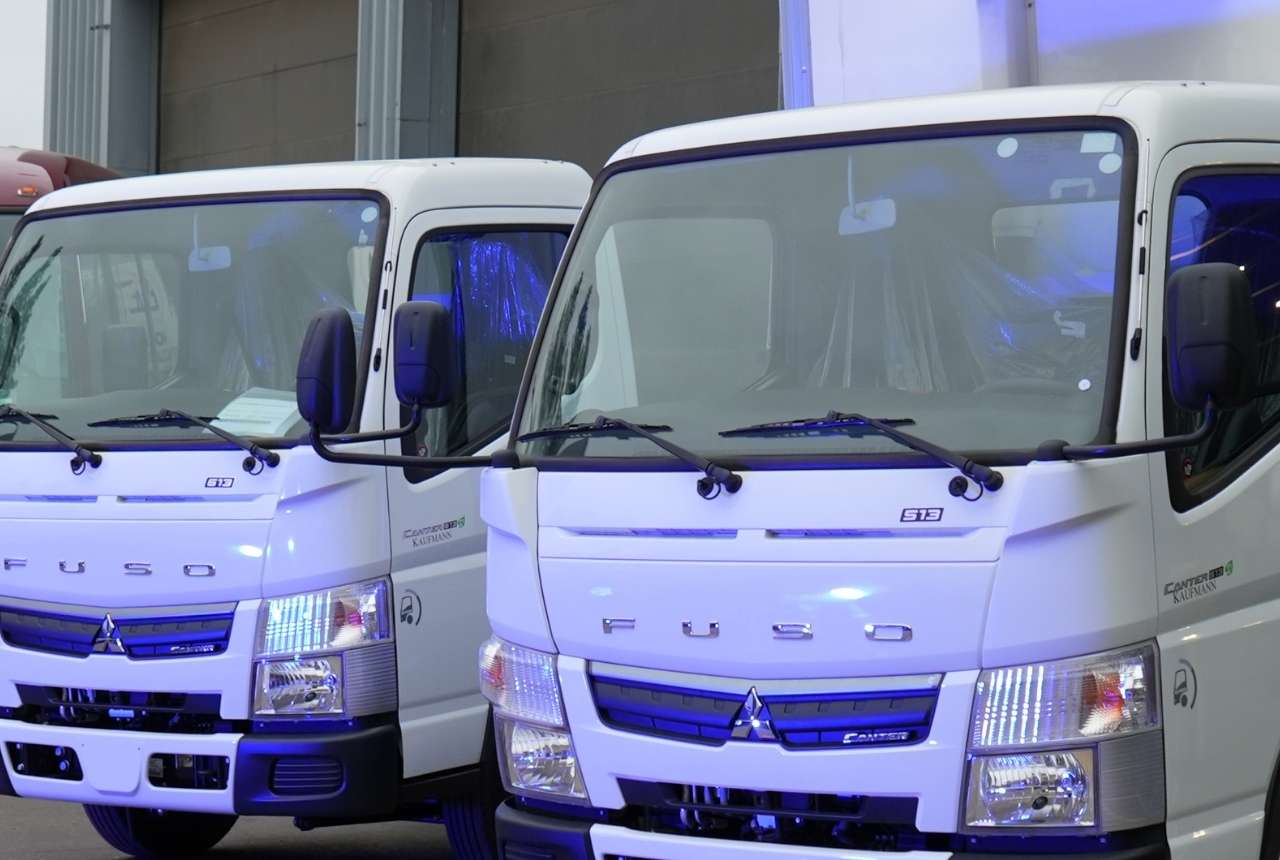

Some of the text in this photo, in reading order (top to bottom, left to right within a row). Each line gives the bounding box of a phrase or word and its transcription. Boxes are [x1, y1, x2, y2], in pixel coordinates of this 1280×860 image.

[901, 508, 943, 521] S13
[4, 558, 216, 577] FUSO
[603, 618, 912, 641] FUSO
